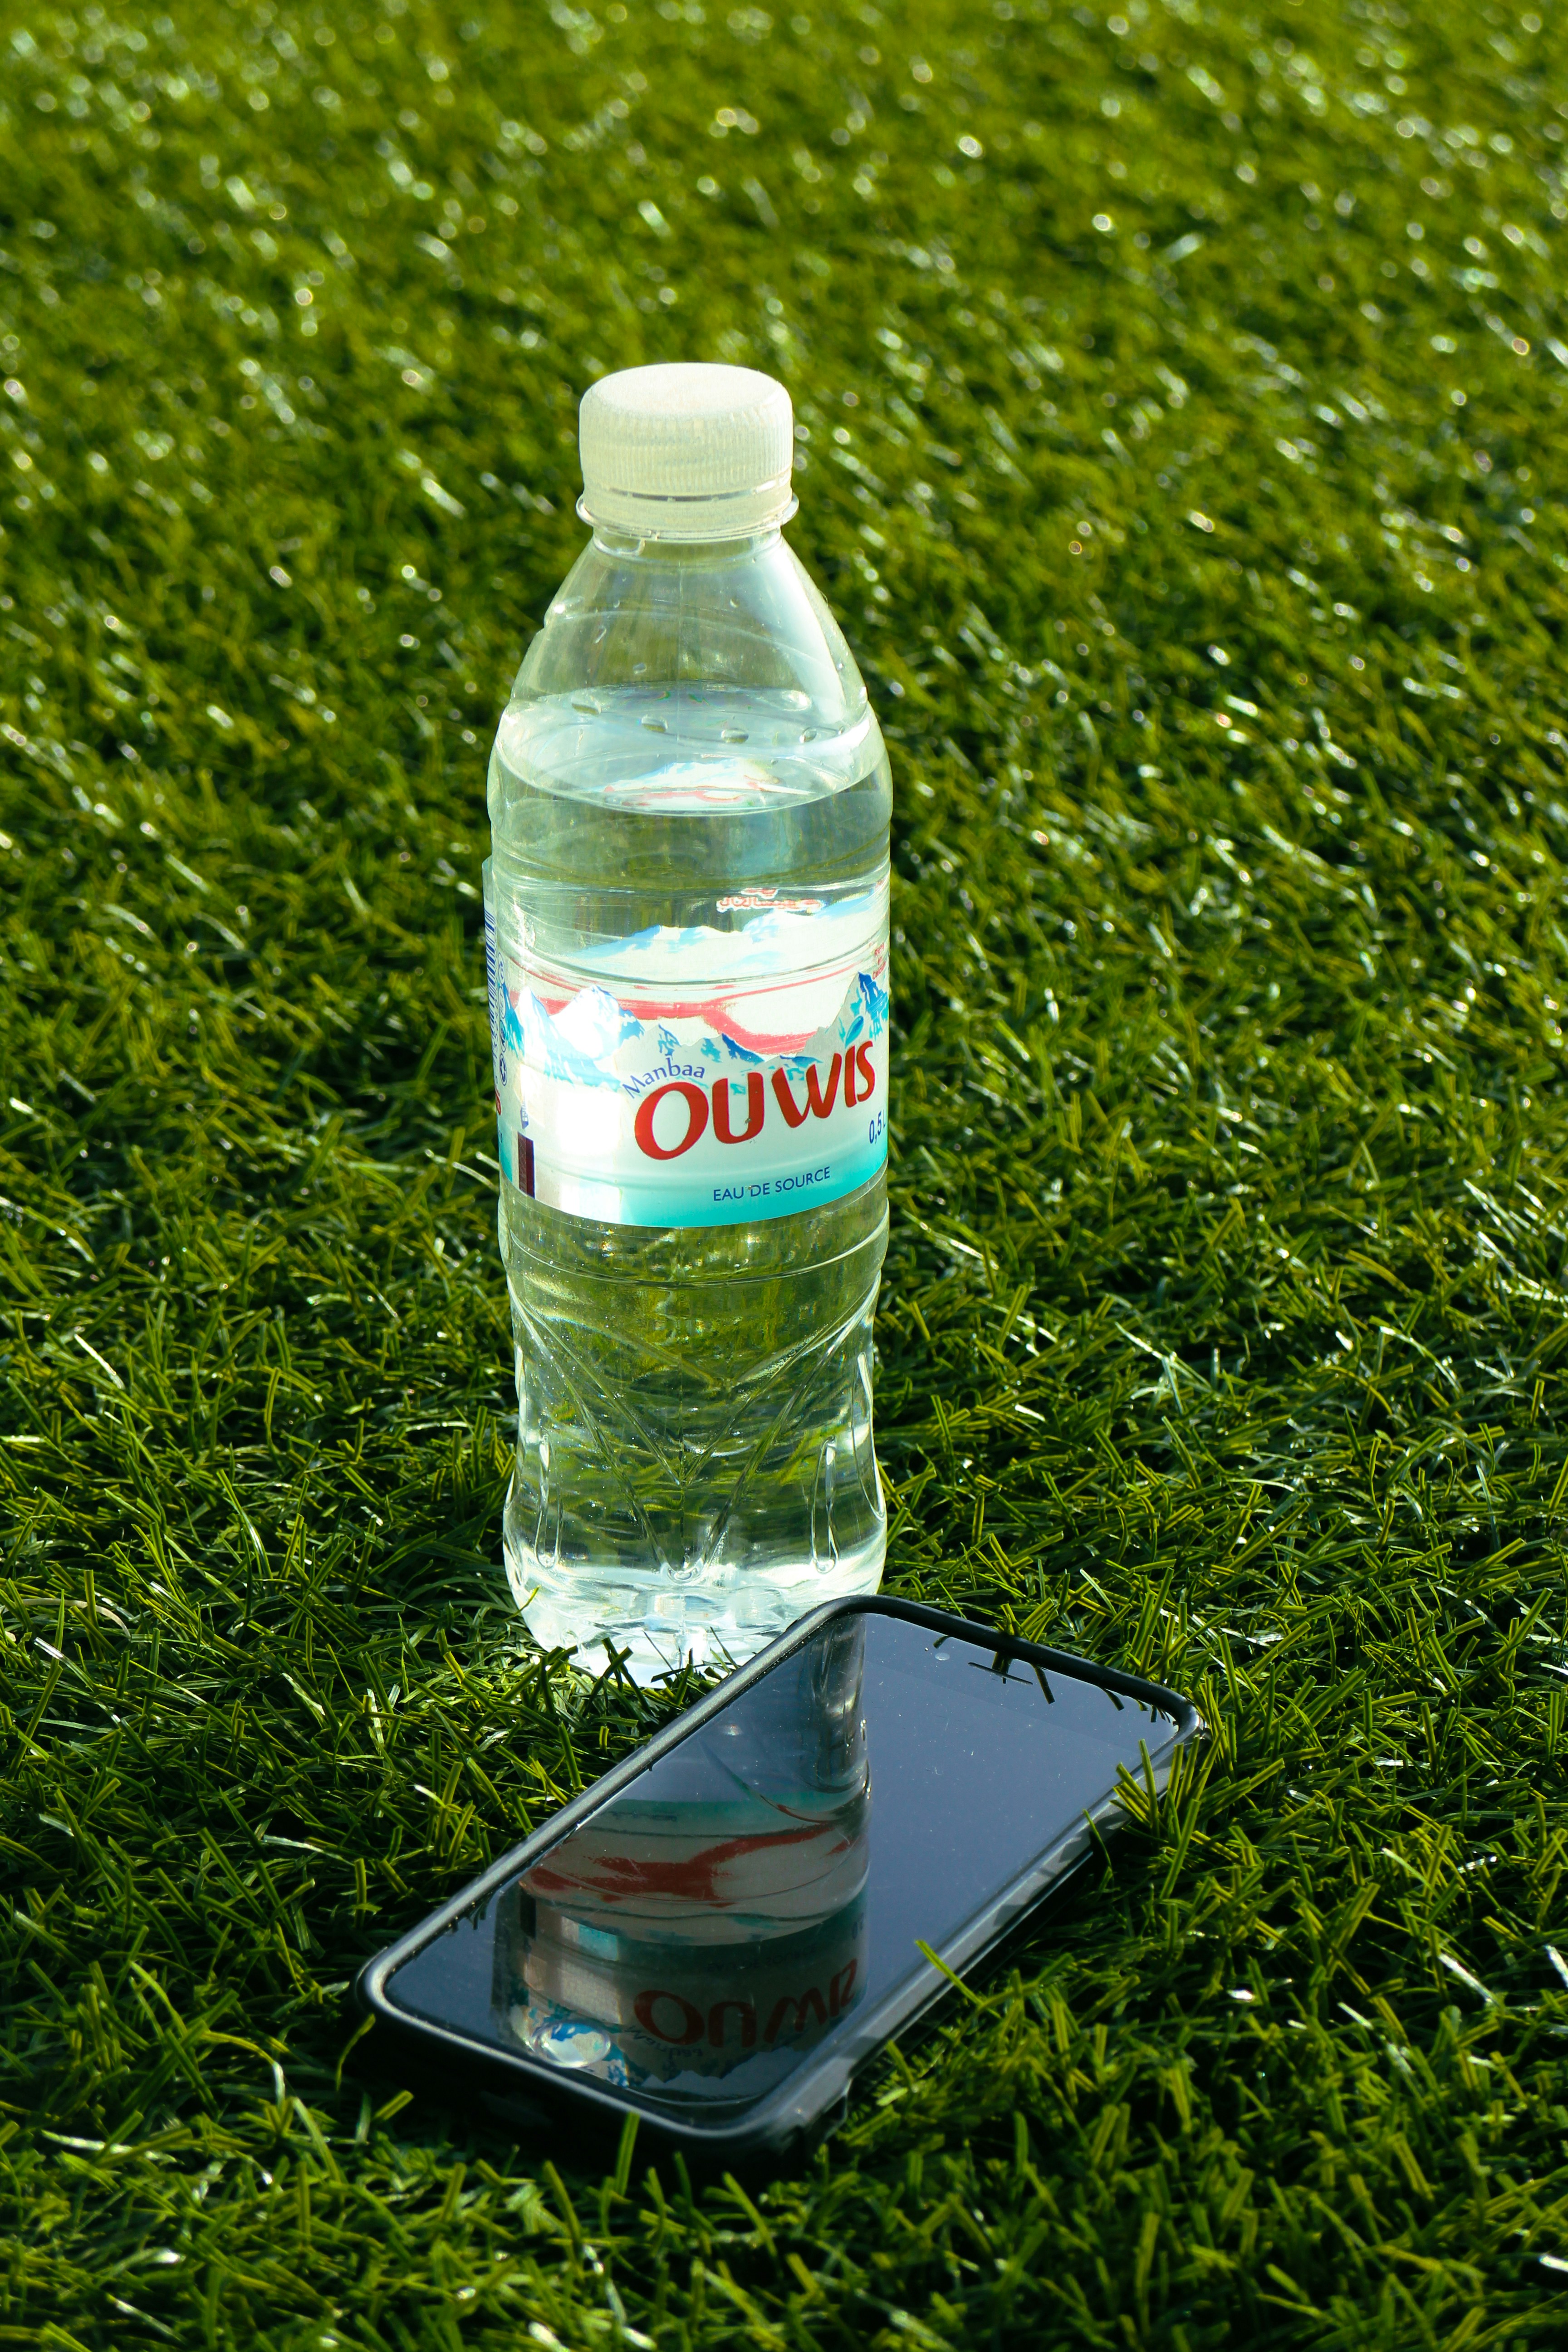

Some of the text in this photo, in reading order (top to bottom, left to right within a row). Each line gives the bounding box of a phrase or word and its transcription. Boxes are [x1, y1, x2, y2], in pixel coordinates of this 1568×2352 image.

[622, 1057, 705, 1099] Manbaa
[635, 1040, 875, 1160] OUWIS
[869, 1110, 882, 1144] 0,5
[714, 1166, 830, 1201] EAU DE SOURCE
